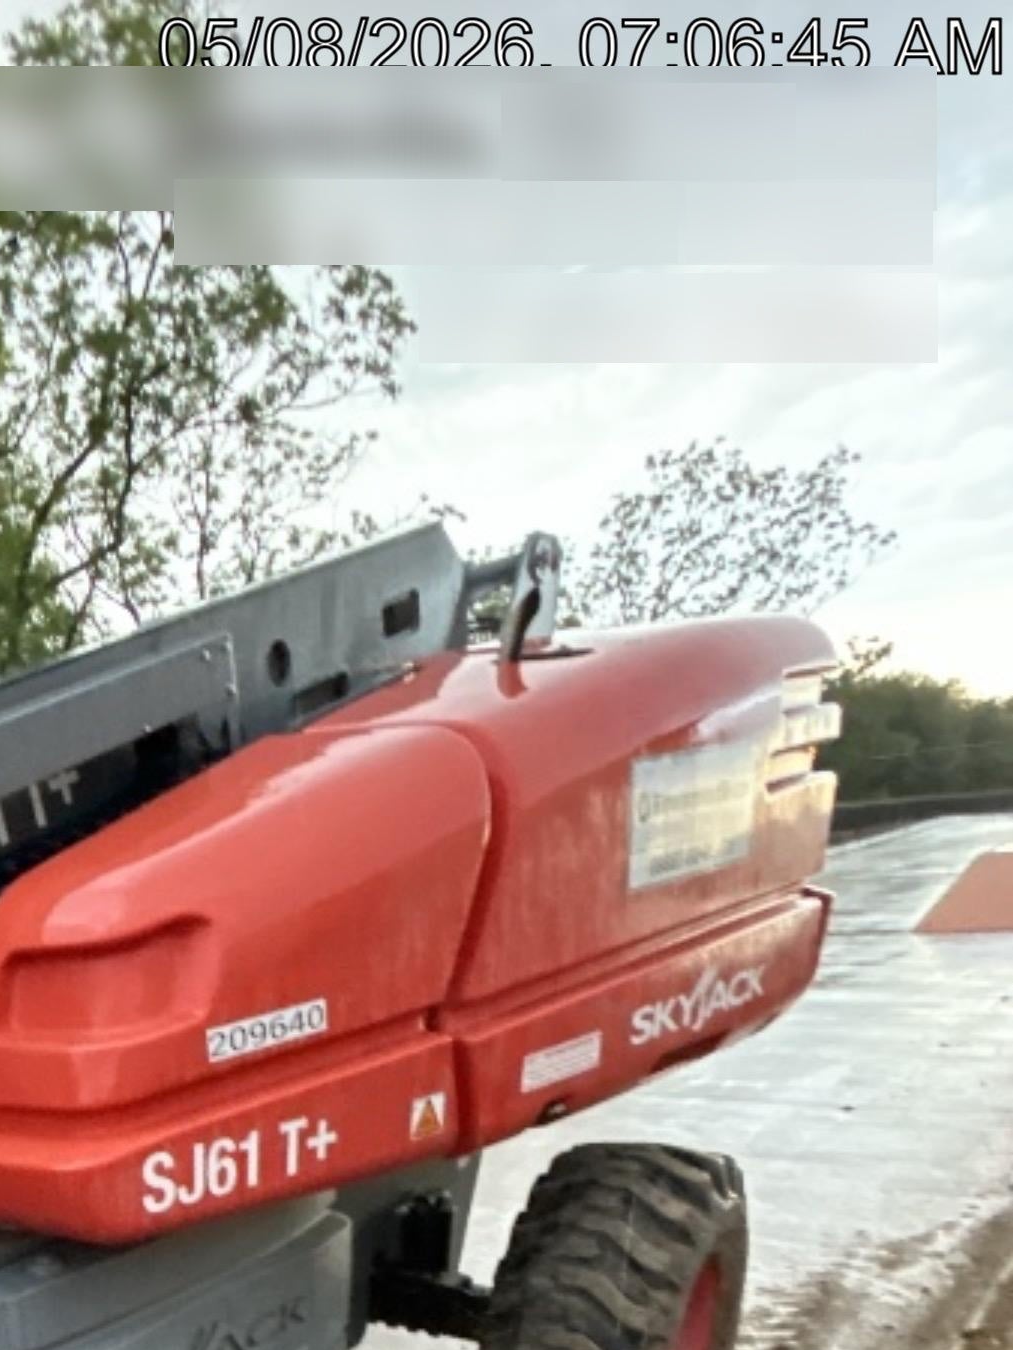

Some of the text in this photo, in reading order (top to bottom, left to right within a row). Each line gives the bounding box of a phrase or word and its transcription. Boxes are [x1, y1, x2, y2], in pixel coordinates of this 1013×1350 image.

[209, 1003, 326, 1057] 209640
[629, 963, 766, 1046] SKYJACK
[141, 1115, 338, 1214] SJ61 T+
